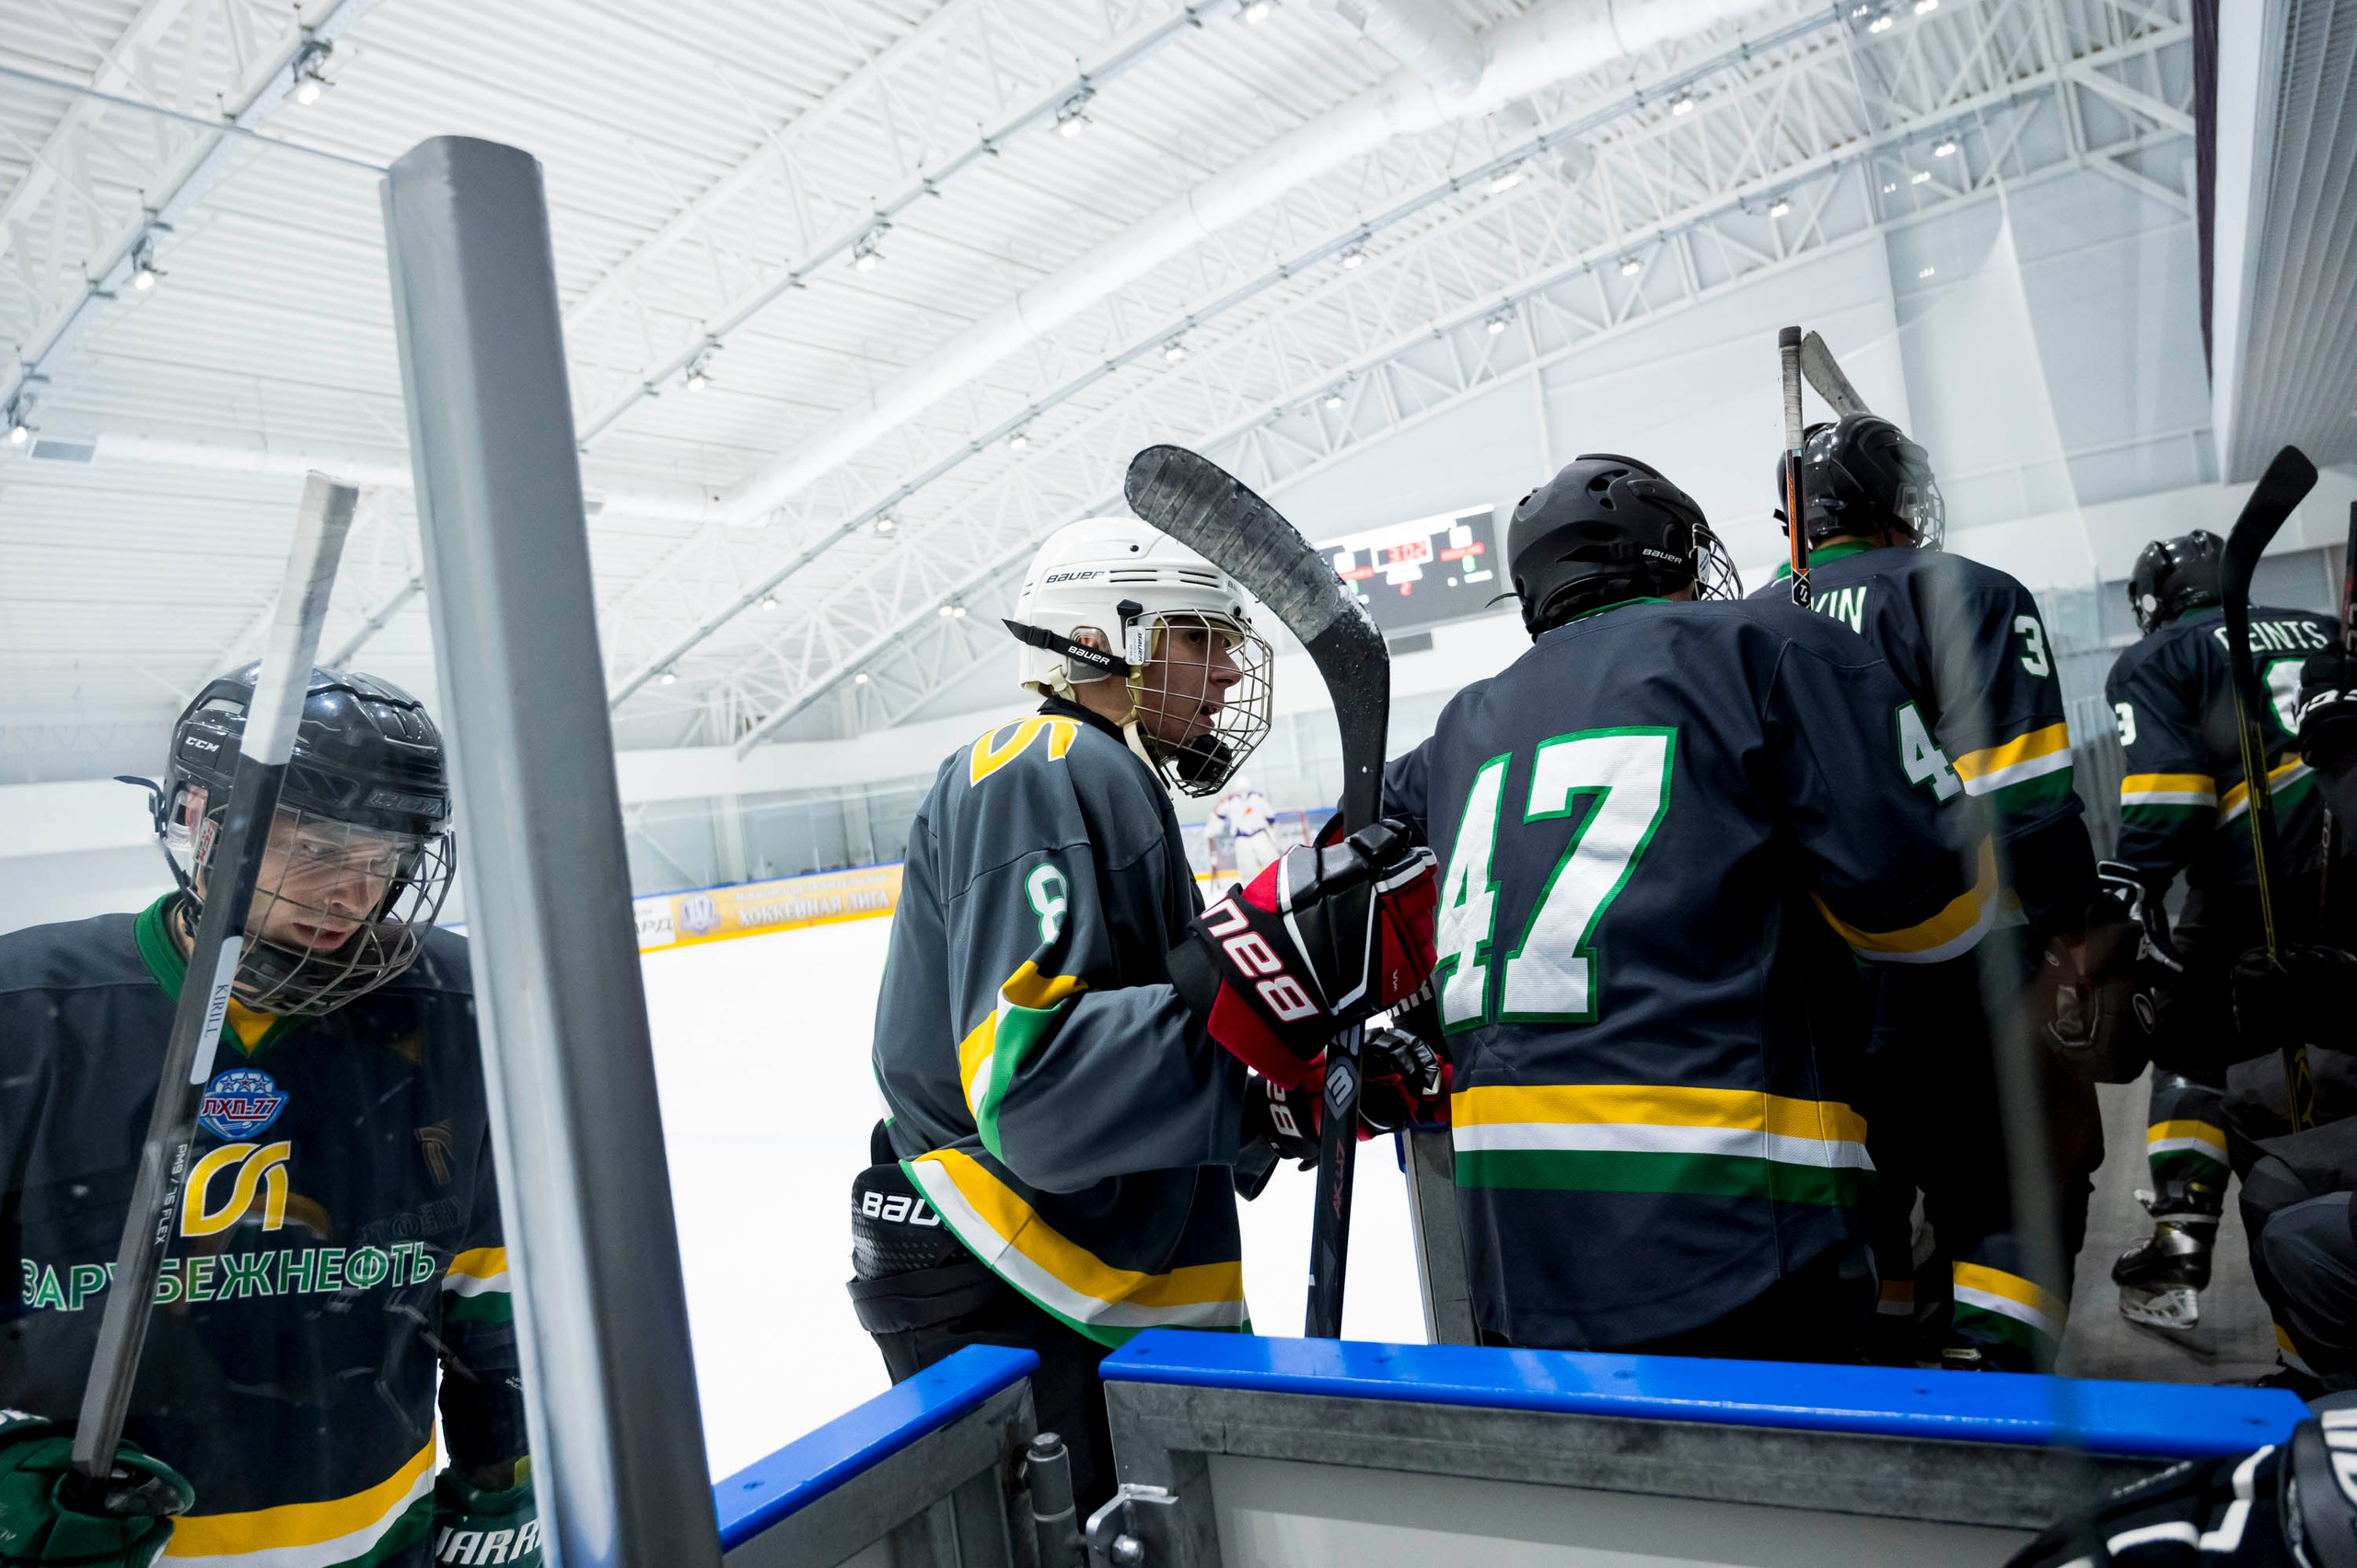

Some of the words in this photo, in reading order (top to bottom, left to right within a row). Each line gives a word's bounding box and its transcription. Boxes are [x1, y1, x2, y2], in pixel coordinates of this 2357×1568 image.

[1068, 645, 1110, 665] BAUER
[2014, 615, 2049, 677] 3
[185, 737, 220, 752] CCM
[1435, 726, 1678, 1035] 47
[203, 984, 229, 1039] KIRILL
[154, 1208, 173, 1246] FLEX
[21, 1241, 435, 1311] ЗАРБЕЖНЕФТЬ
